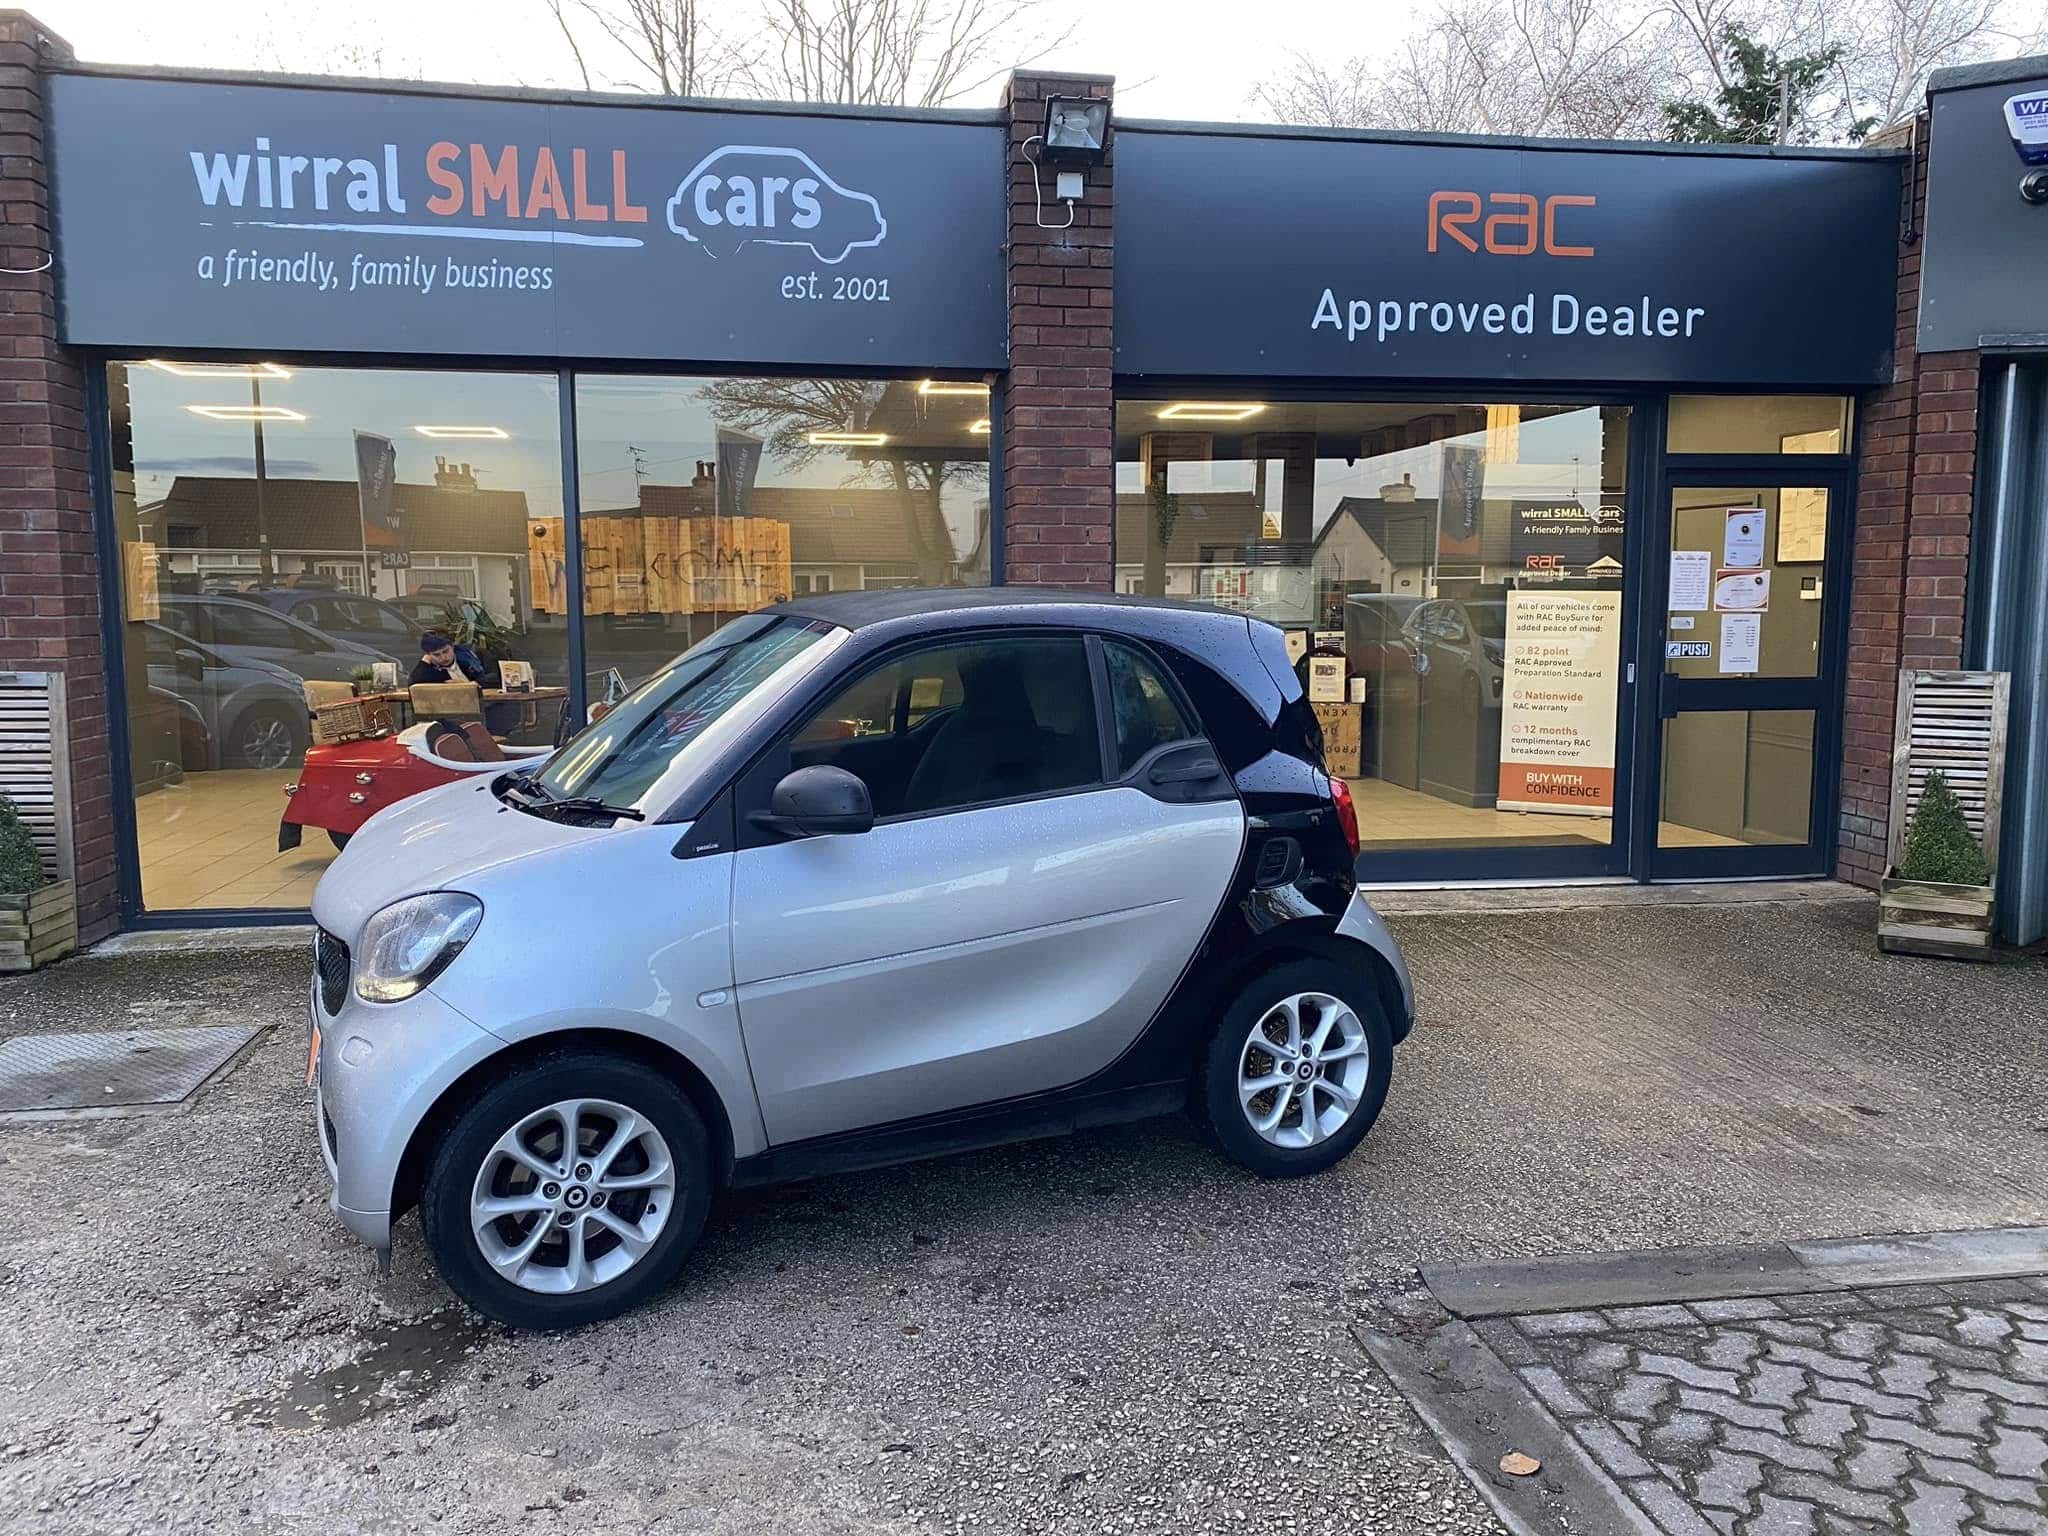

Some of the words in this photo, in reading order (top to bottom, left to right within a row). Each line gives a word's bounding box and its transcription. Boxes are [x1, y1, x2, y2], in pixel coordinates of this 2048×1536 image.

[189, 137, 407, 214] wirral
[425, 142, 648, 223] SMALL
[694, 174, 823, 229] cars
[197, 255, 214, 280] a
[222, 249, 340, 291] friendly,
[350, 253, 438, 294] family
[445, 258, 554, 291] business
[780, 271, 823, 299] est.
[833, 276, 891, 301] 2001
[1311, 288, 1535, 342] Approved
[1552, 294, 1705, 337] Dealer
[1521, 508, 1552, 518] wirral
[1554, 508, 1590, 518] SMALL
[1599, 510, 1620, 518] cars
[1524, 526, 1531, 534] A
[1532, 526, 1564, 536] Friendly
[1565, 526, 1592, 536] Family
[1593, 526, 1624, 534] Busines
[1517, 602, 1528, 610] All
[1530, 602, 1539, 610] of
[1556, 603, 1590, 611] vehicles
[1517, 613, 1534, 621] with
[1536, 613, 1553, 621] RAC
[1555, 614, 1590, 623] BuySure
[1516, 624, 1540, 632] added
[1543, 625, 1567, 633] peace
[1527, 646, 1539, 655] 82
[1543, 647, 1569, 657] point
[1682, 643, 1709, 656] PUSH
[1514, 658, 1532, 666] RAC
[1534, 659, 1572, 667] Approved
[1514, 668, 1561, 677] Preparation
[1564, 669, 1601, 678] Standard
[1525, 691, 1584, 702] Nationwide
[1512, 702, 1529, 710] RAC
[1532, 703, 1569, 713] warranty
[1524, 725, 1536, 734] 12
[1540, 726, 1578, 736] months
[1511, 737, 1571, 747] complimentary
[1574, 738, 1591, 747] RAC
[1511, 747, 1555, 756] breakdown
[1558, 749, 1580, 757] cover
[1526, 772, 1550, 783] BUY
[1551, 773, 1583, 785] WITH
[1526, 783, 1601, 798] CONFIDENCE
